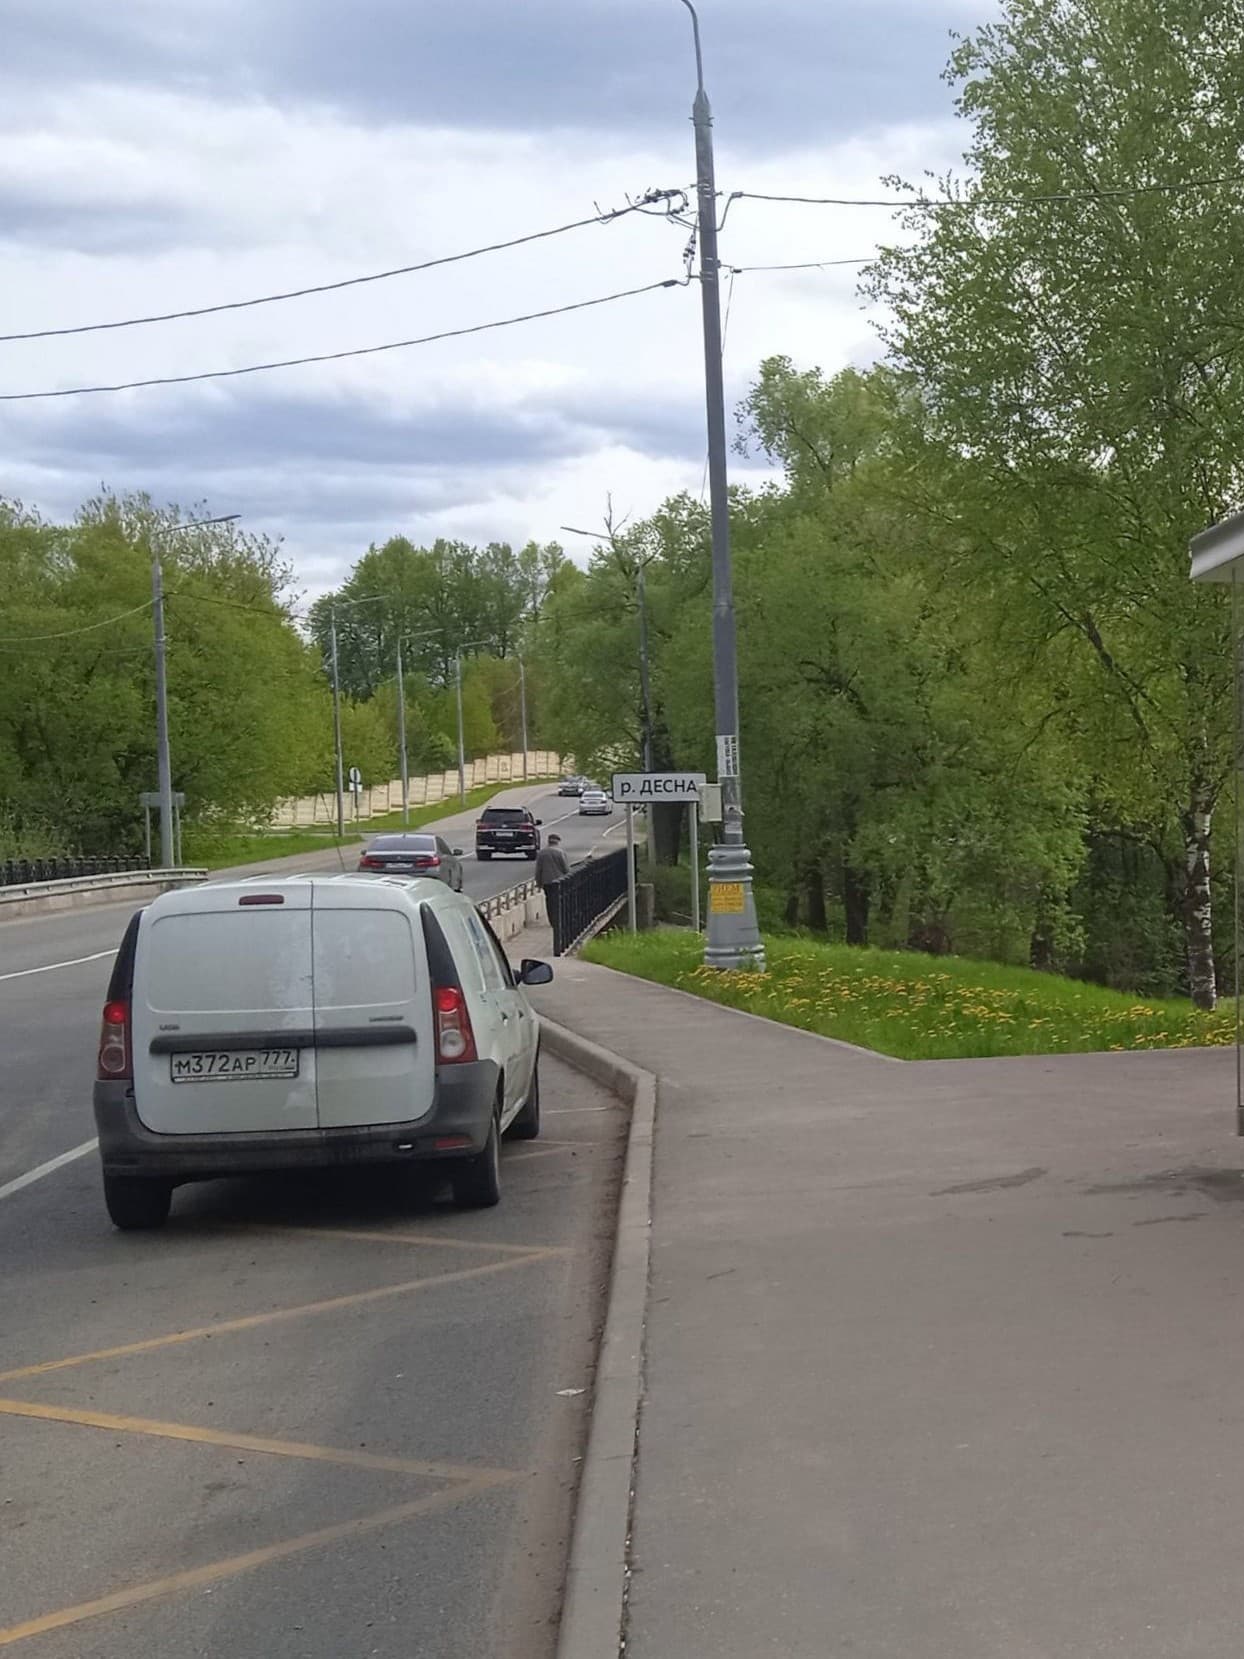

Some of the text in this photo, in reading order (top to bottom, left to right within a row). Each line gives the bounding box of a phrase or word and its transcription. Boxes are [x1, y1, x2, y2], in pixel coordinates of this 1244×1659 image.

[621, 779, 697, 796] р. ДЕСНА
[261, 1051, 291, 1065] 777
